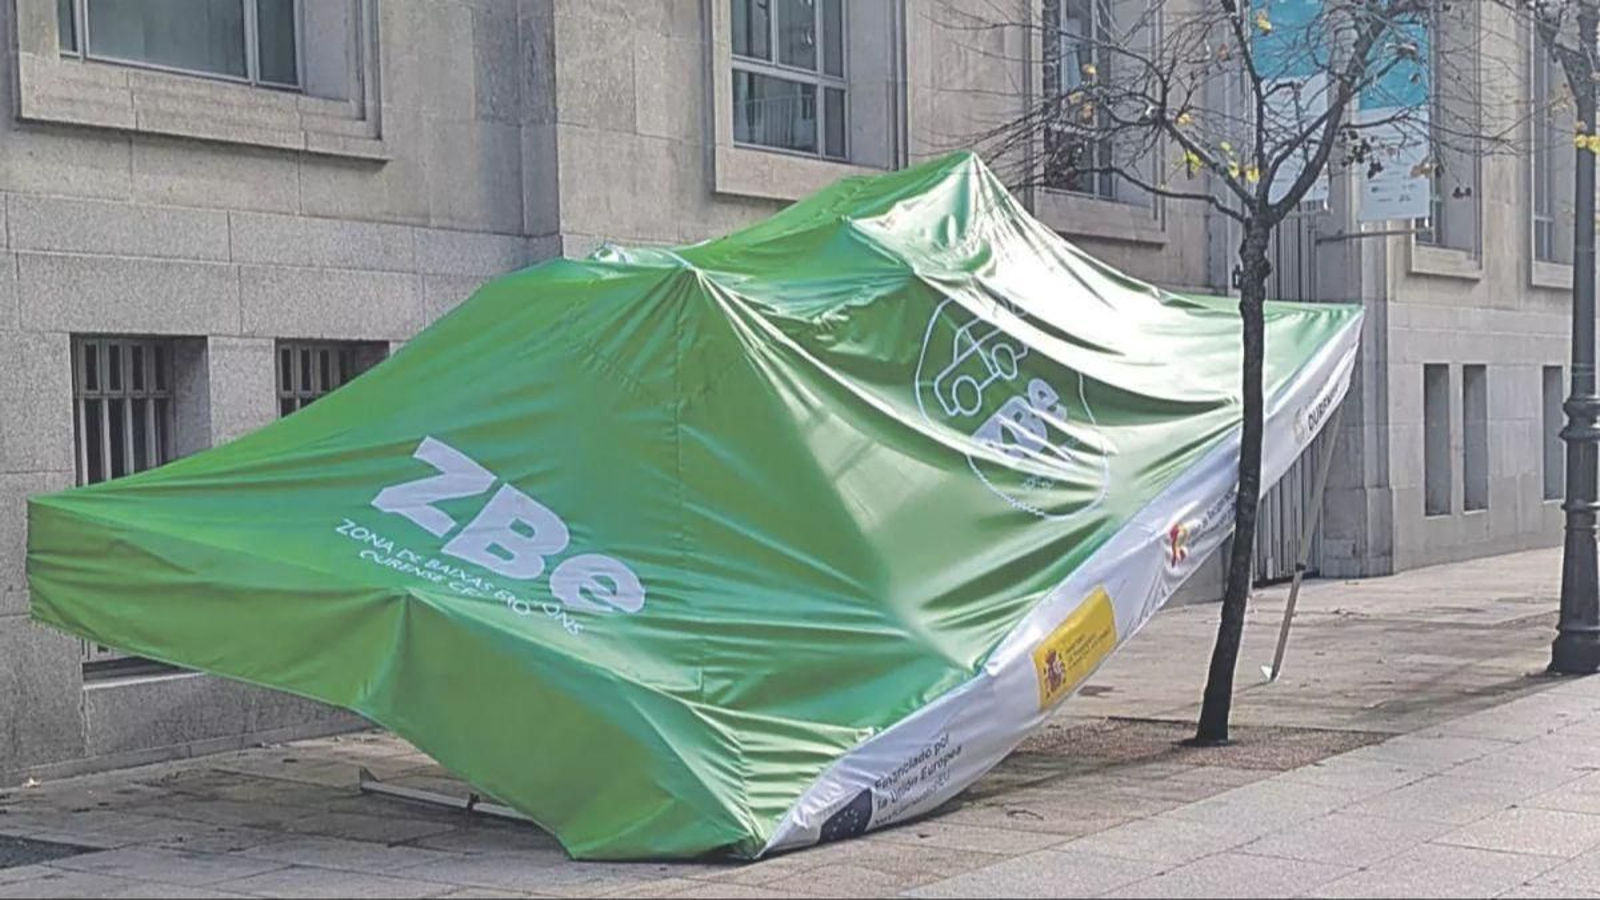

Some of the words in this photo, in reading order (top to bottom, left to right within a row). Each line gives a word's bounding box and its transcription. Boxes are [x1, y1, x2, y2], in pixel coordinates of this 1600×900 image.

[370, 435, 646, 614] ZBe
[335, 518, 395, 555] ZONA
[424, 558, 495, 592] BAIXAS
[359, 549, 447, 583] OURENSE
[874, 747, 932, 790] Financiado
[920, 743, 962, 781] Europea
